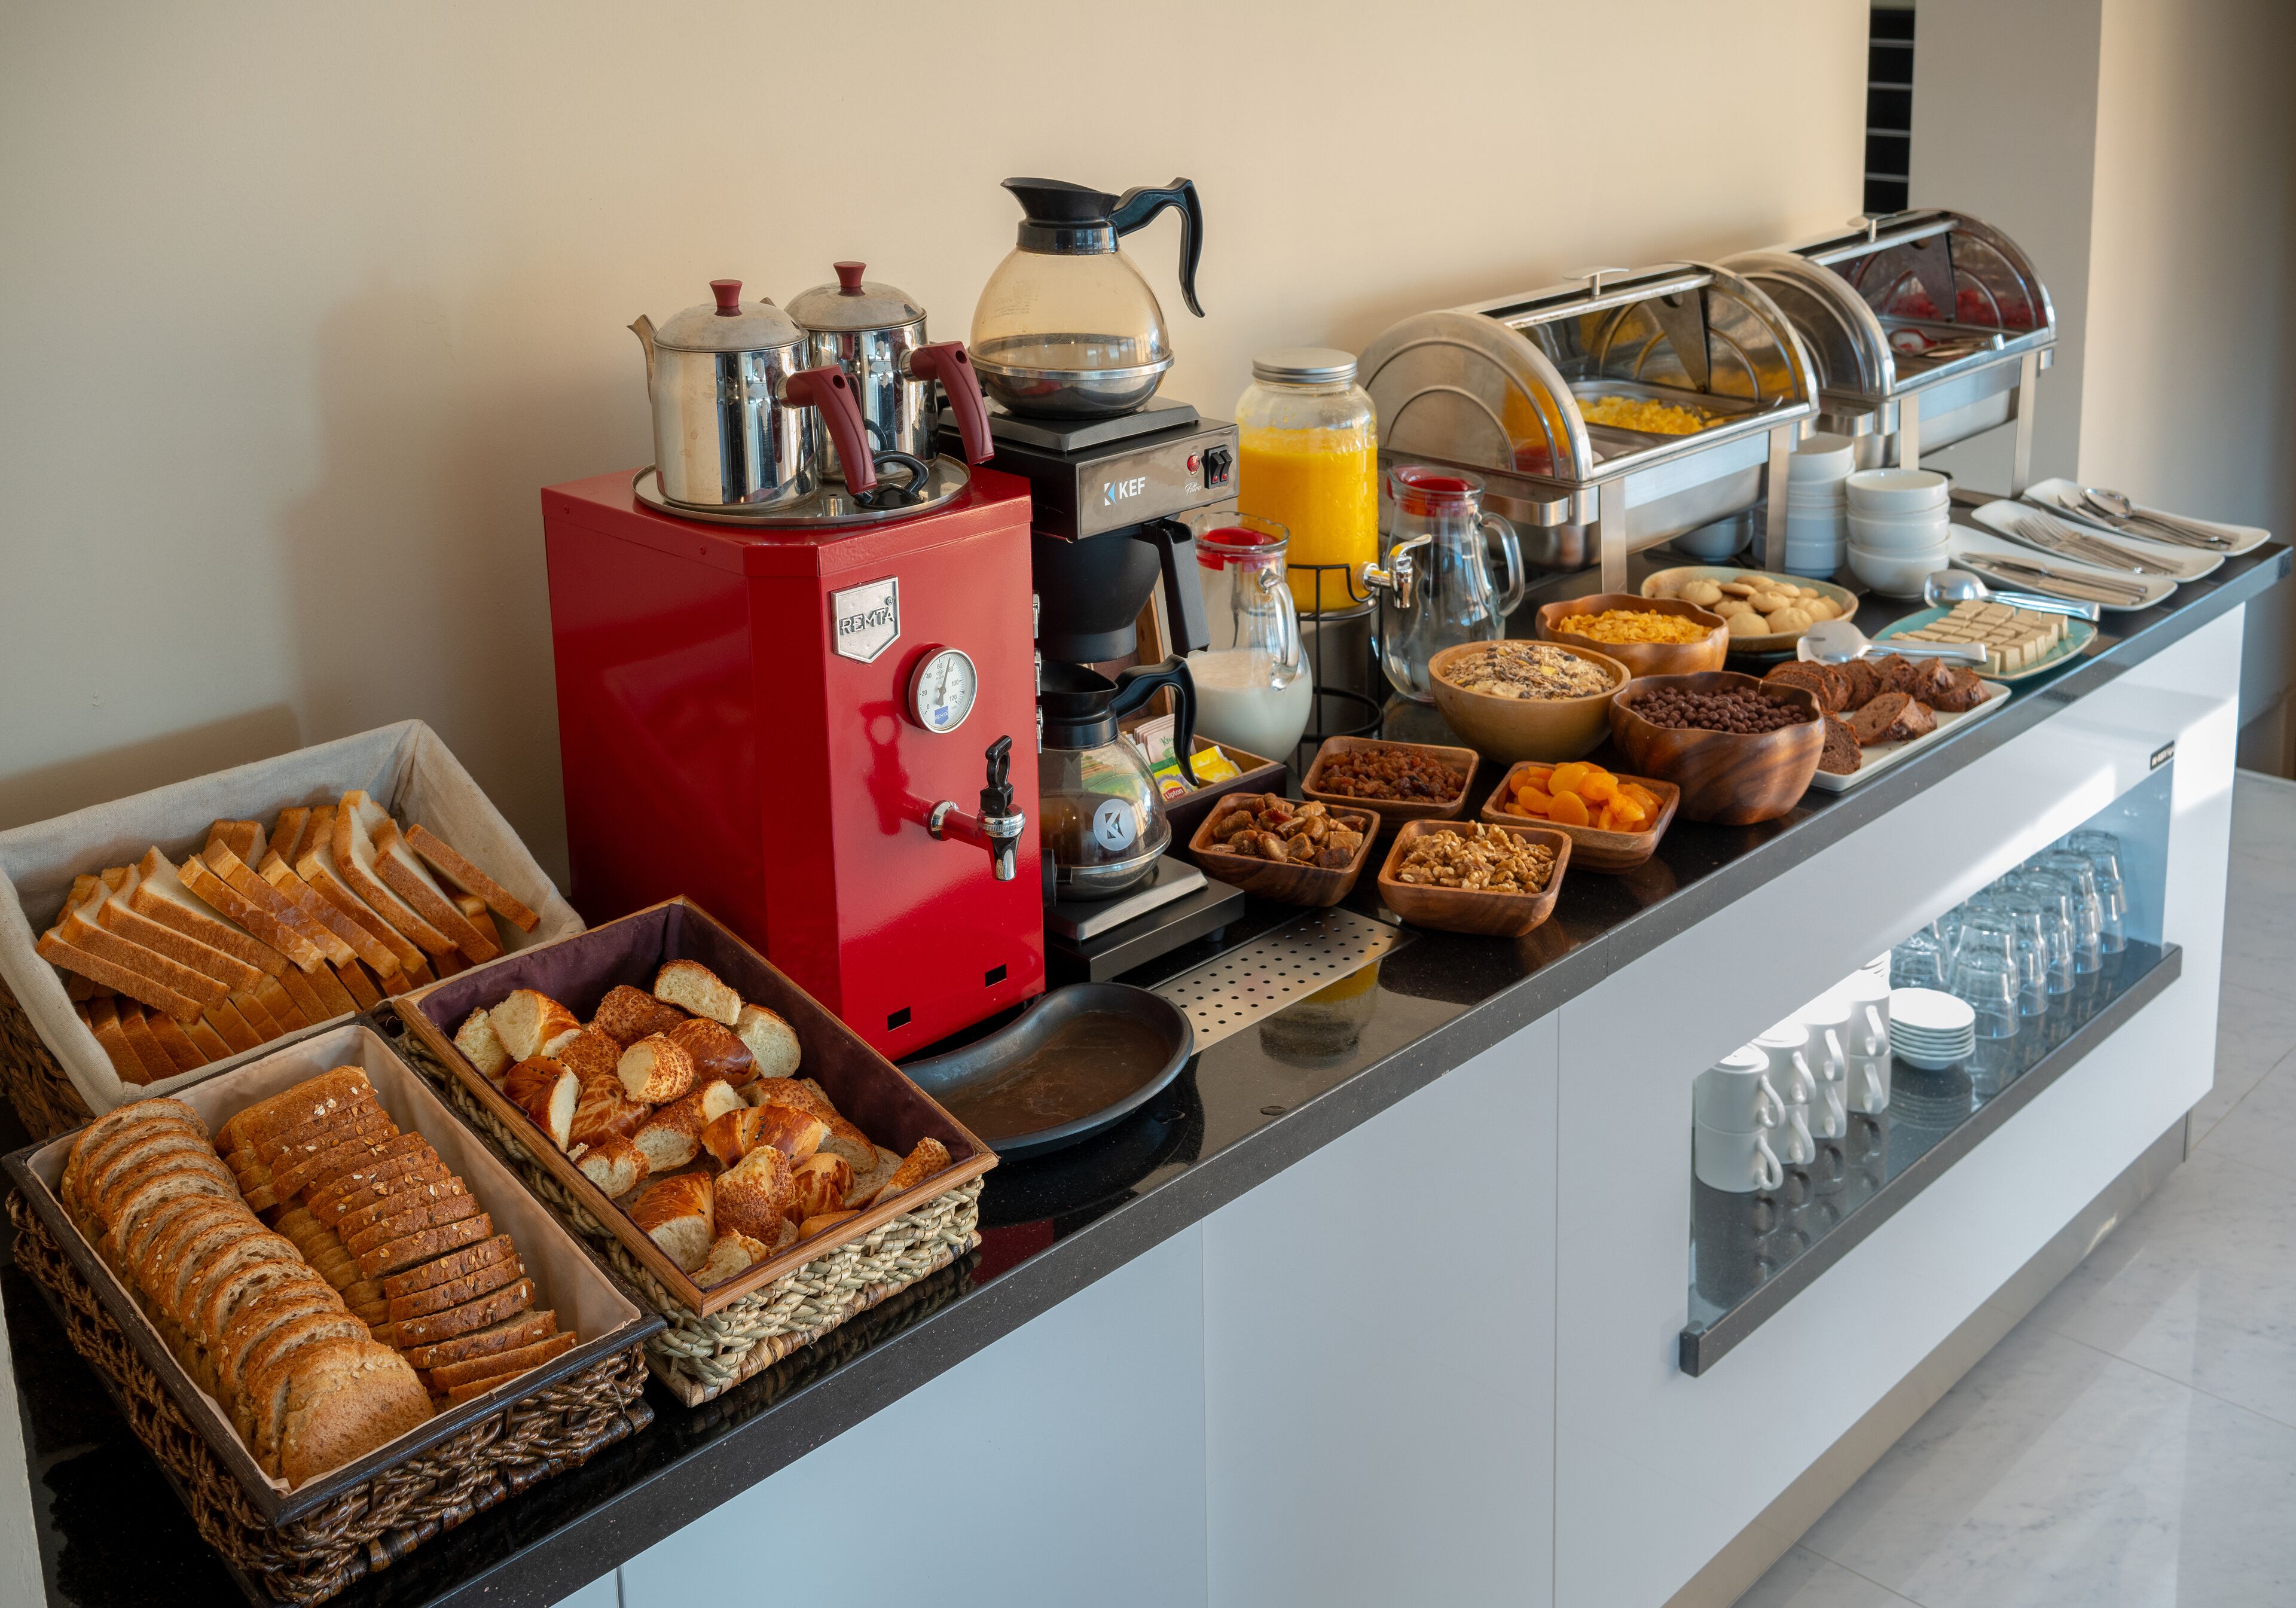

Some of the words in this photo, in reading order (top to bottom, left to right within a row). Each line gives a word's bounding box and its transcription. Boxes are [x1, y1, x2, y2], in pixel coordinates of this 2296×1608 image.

[1119, 477, 1146, 499] KEF
[1184, 482, 1202, 496] Filtro
[839, 607, 895, 635] REMTA
[1165, 788, 1184, 800] Lipton
